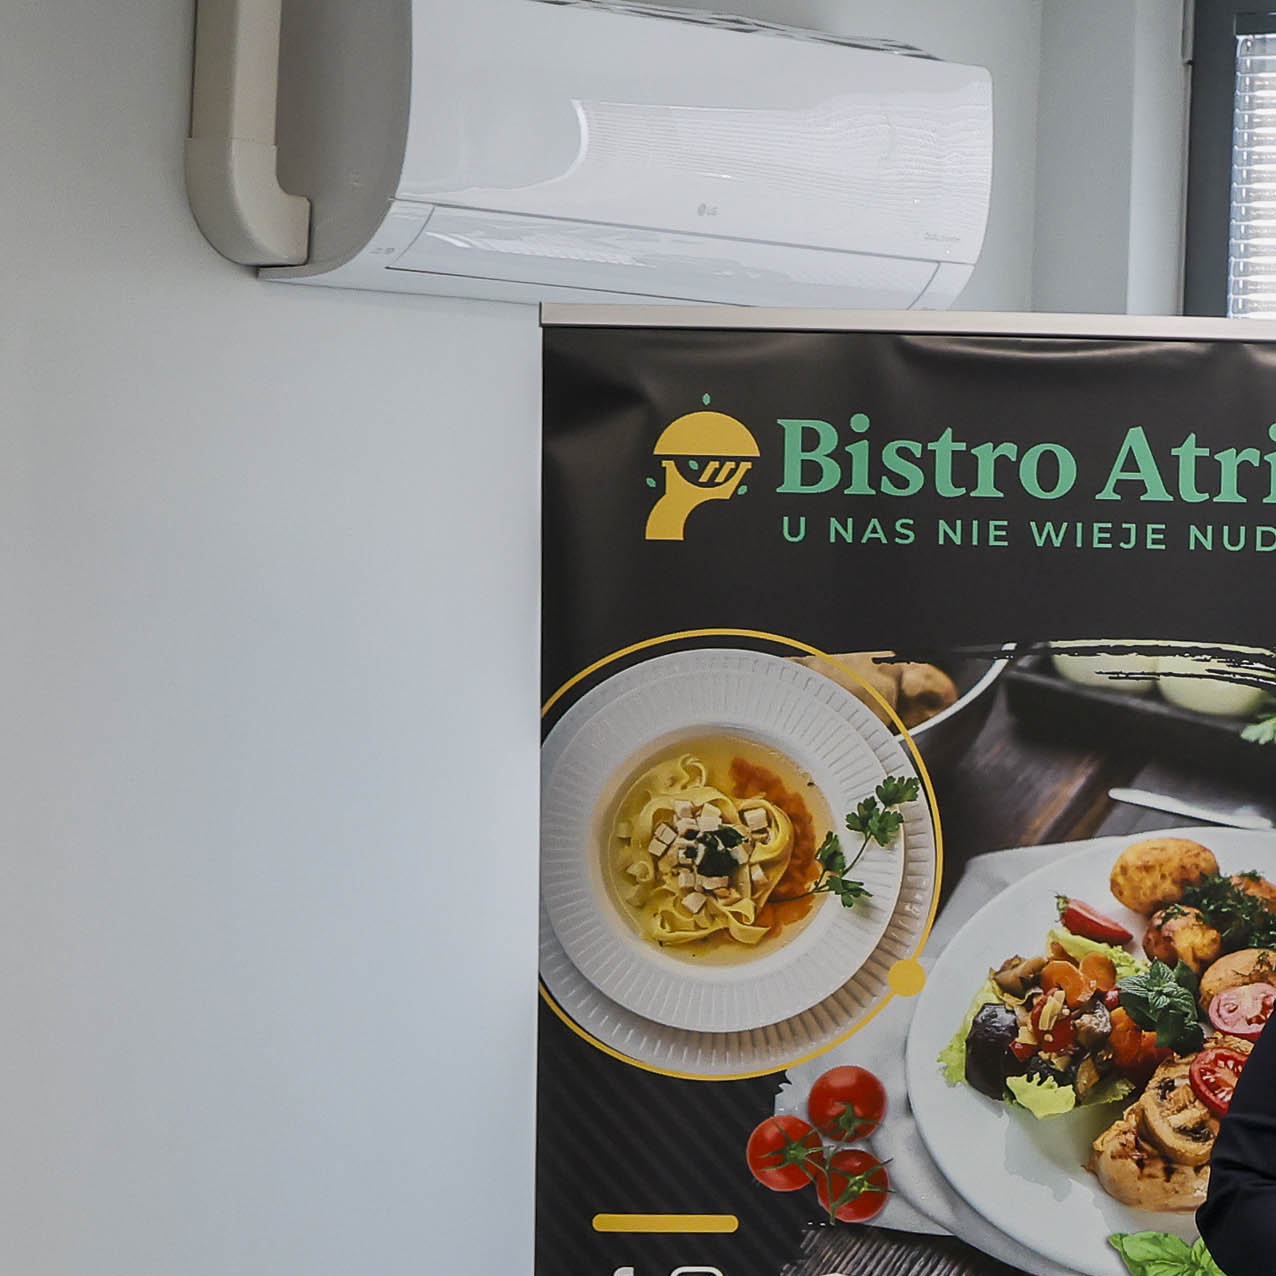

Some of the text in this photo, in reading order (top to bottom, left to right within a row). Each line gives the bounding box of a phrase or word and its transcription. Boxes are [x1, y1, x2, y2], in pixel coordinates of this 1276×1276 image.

[776, 414, 1076, 499] Bistro
[783, 517, 805, 541] U
[830, 518, 914, 544] NAS
[939, 520, 1008, 545] NIE
[1030, 522, 1165, 549] WIEJE
